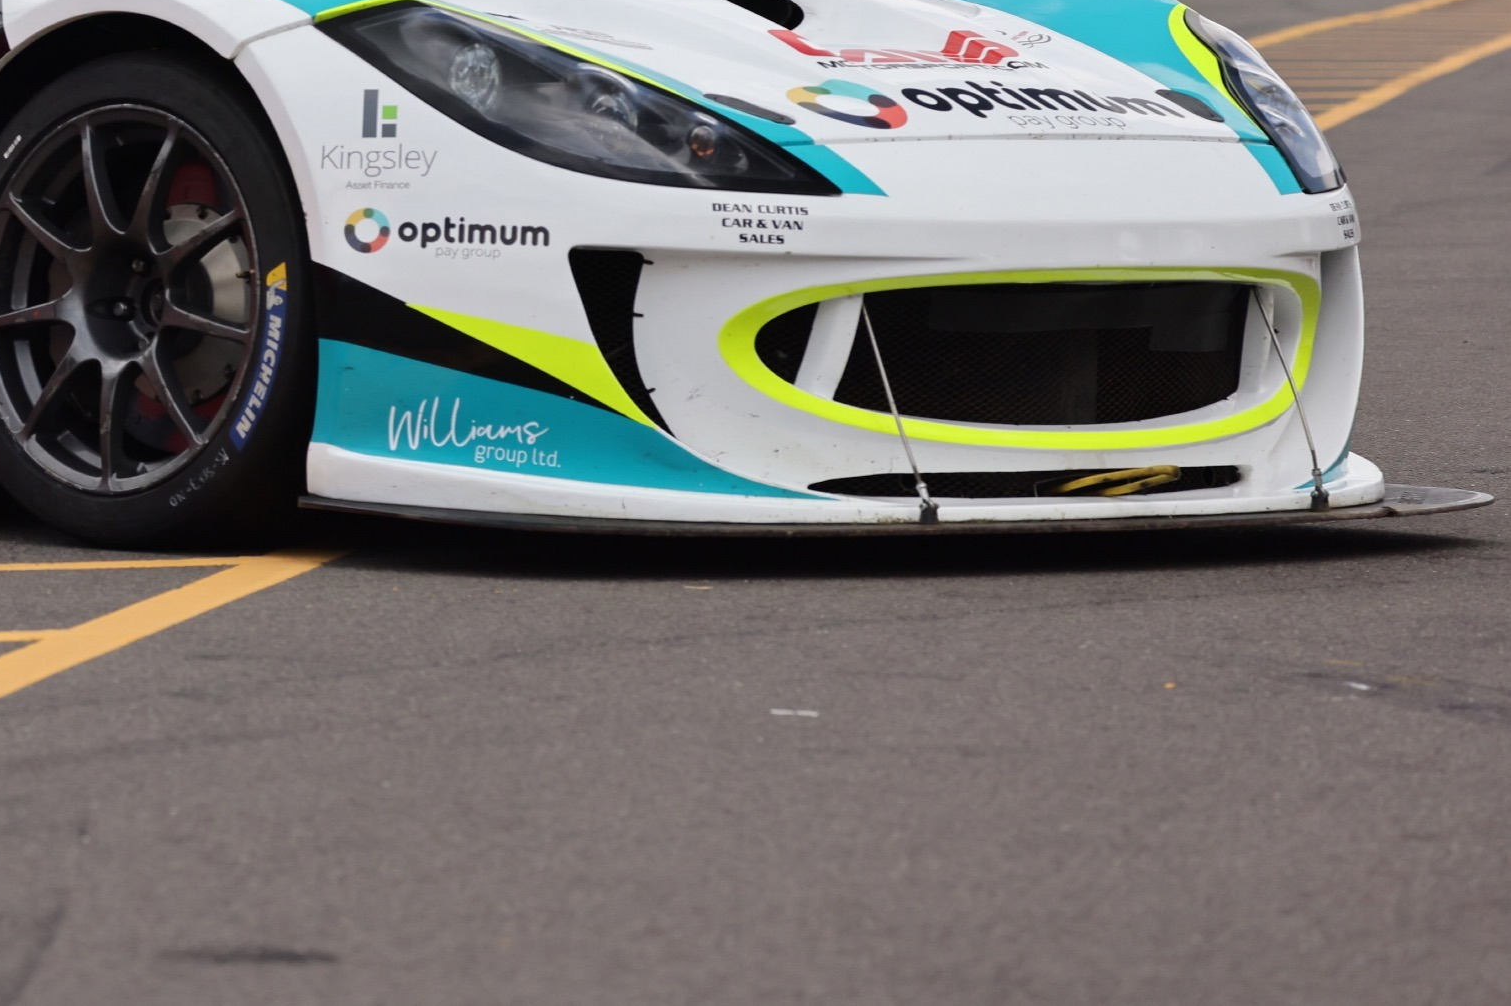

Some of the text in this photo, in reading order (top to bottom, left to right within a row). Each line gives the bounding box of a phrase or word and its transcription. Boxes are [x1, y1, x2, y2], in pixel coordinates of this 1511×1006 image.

[901, 81, 1185, 118] optimum
[1007, 114, 1127, 130] pay group
[320, 143, 438, 177] Kingsley
[345, 180, 410, 190] Asset Finance
[712, 202, 809, 216] DEAN CURTIS
[398, 217, 550, 249] optimum
[722, 217, 804, 231] CAR & VAN
[739, 233, 785, 245] SALES
[435, 247, 501, 260] pay group
[235, 315, 283, 439] MICHELIN
[389, 396, 549, 451] Williams
[474, 444, 561, 468] group ltd.
